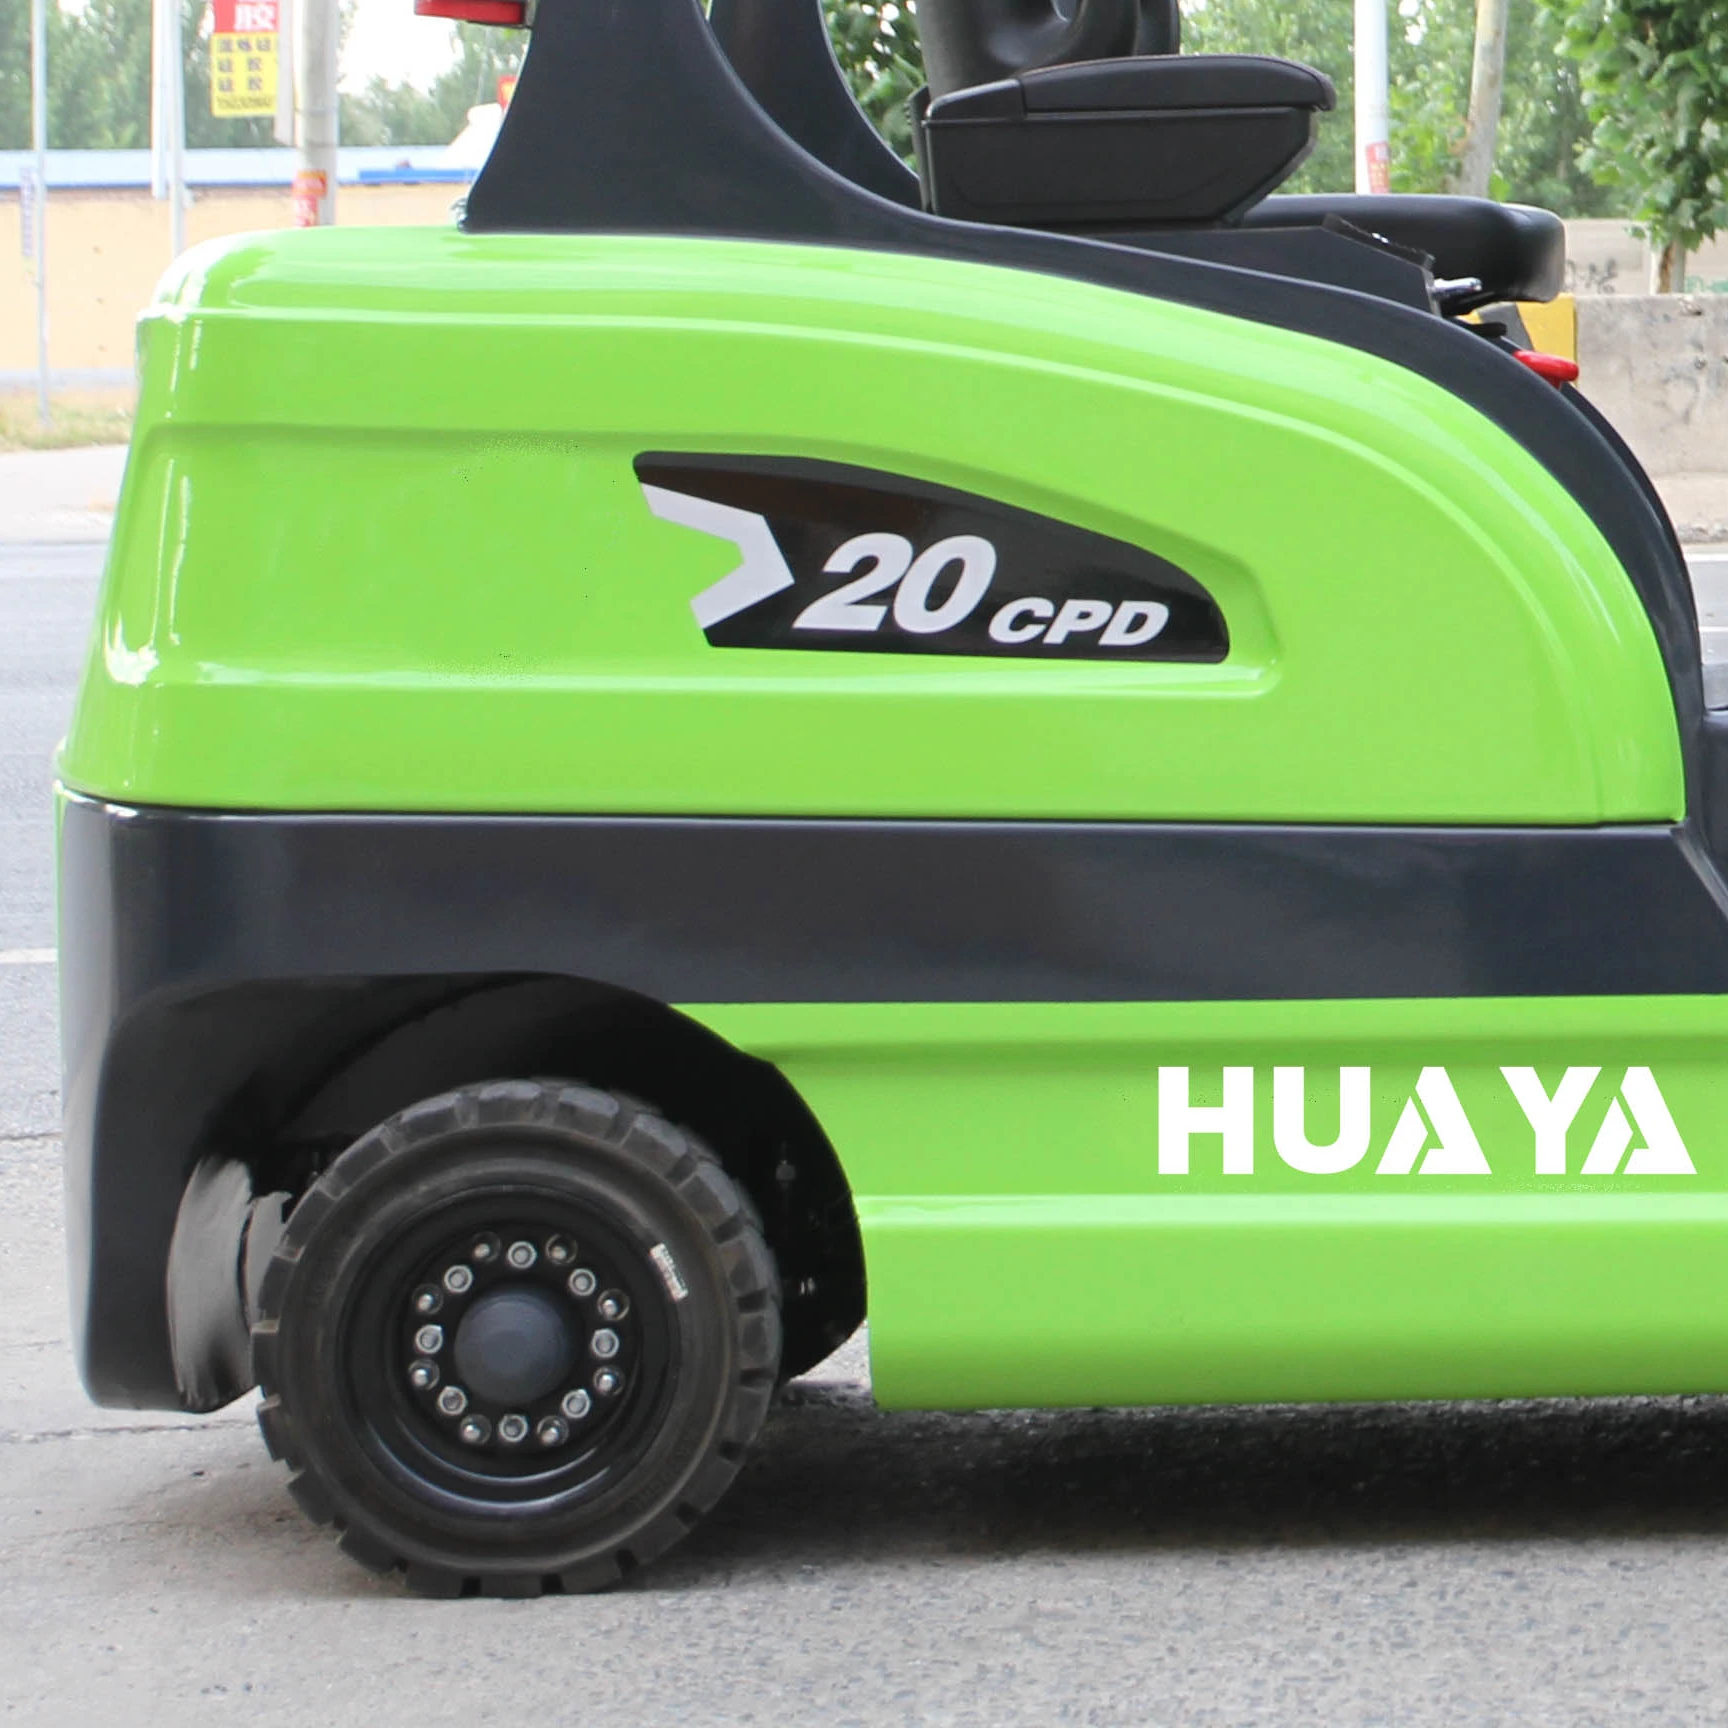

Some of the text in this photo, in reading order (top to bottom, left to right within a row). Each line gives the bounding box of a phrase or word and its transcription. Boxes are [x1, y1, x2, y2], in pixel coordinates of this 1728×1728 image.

[792, 532, 1170, 646] 20 CPD
[1158, 1066, 1698, 1174] HUAYA
